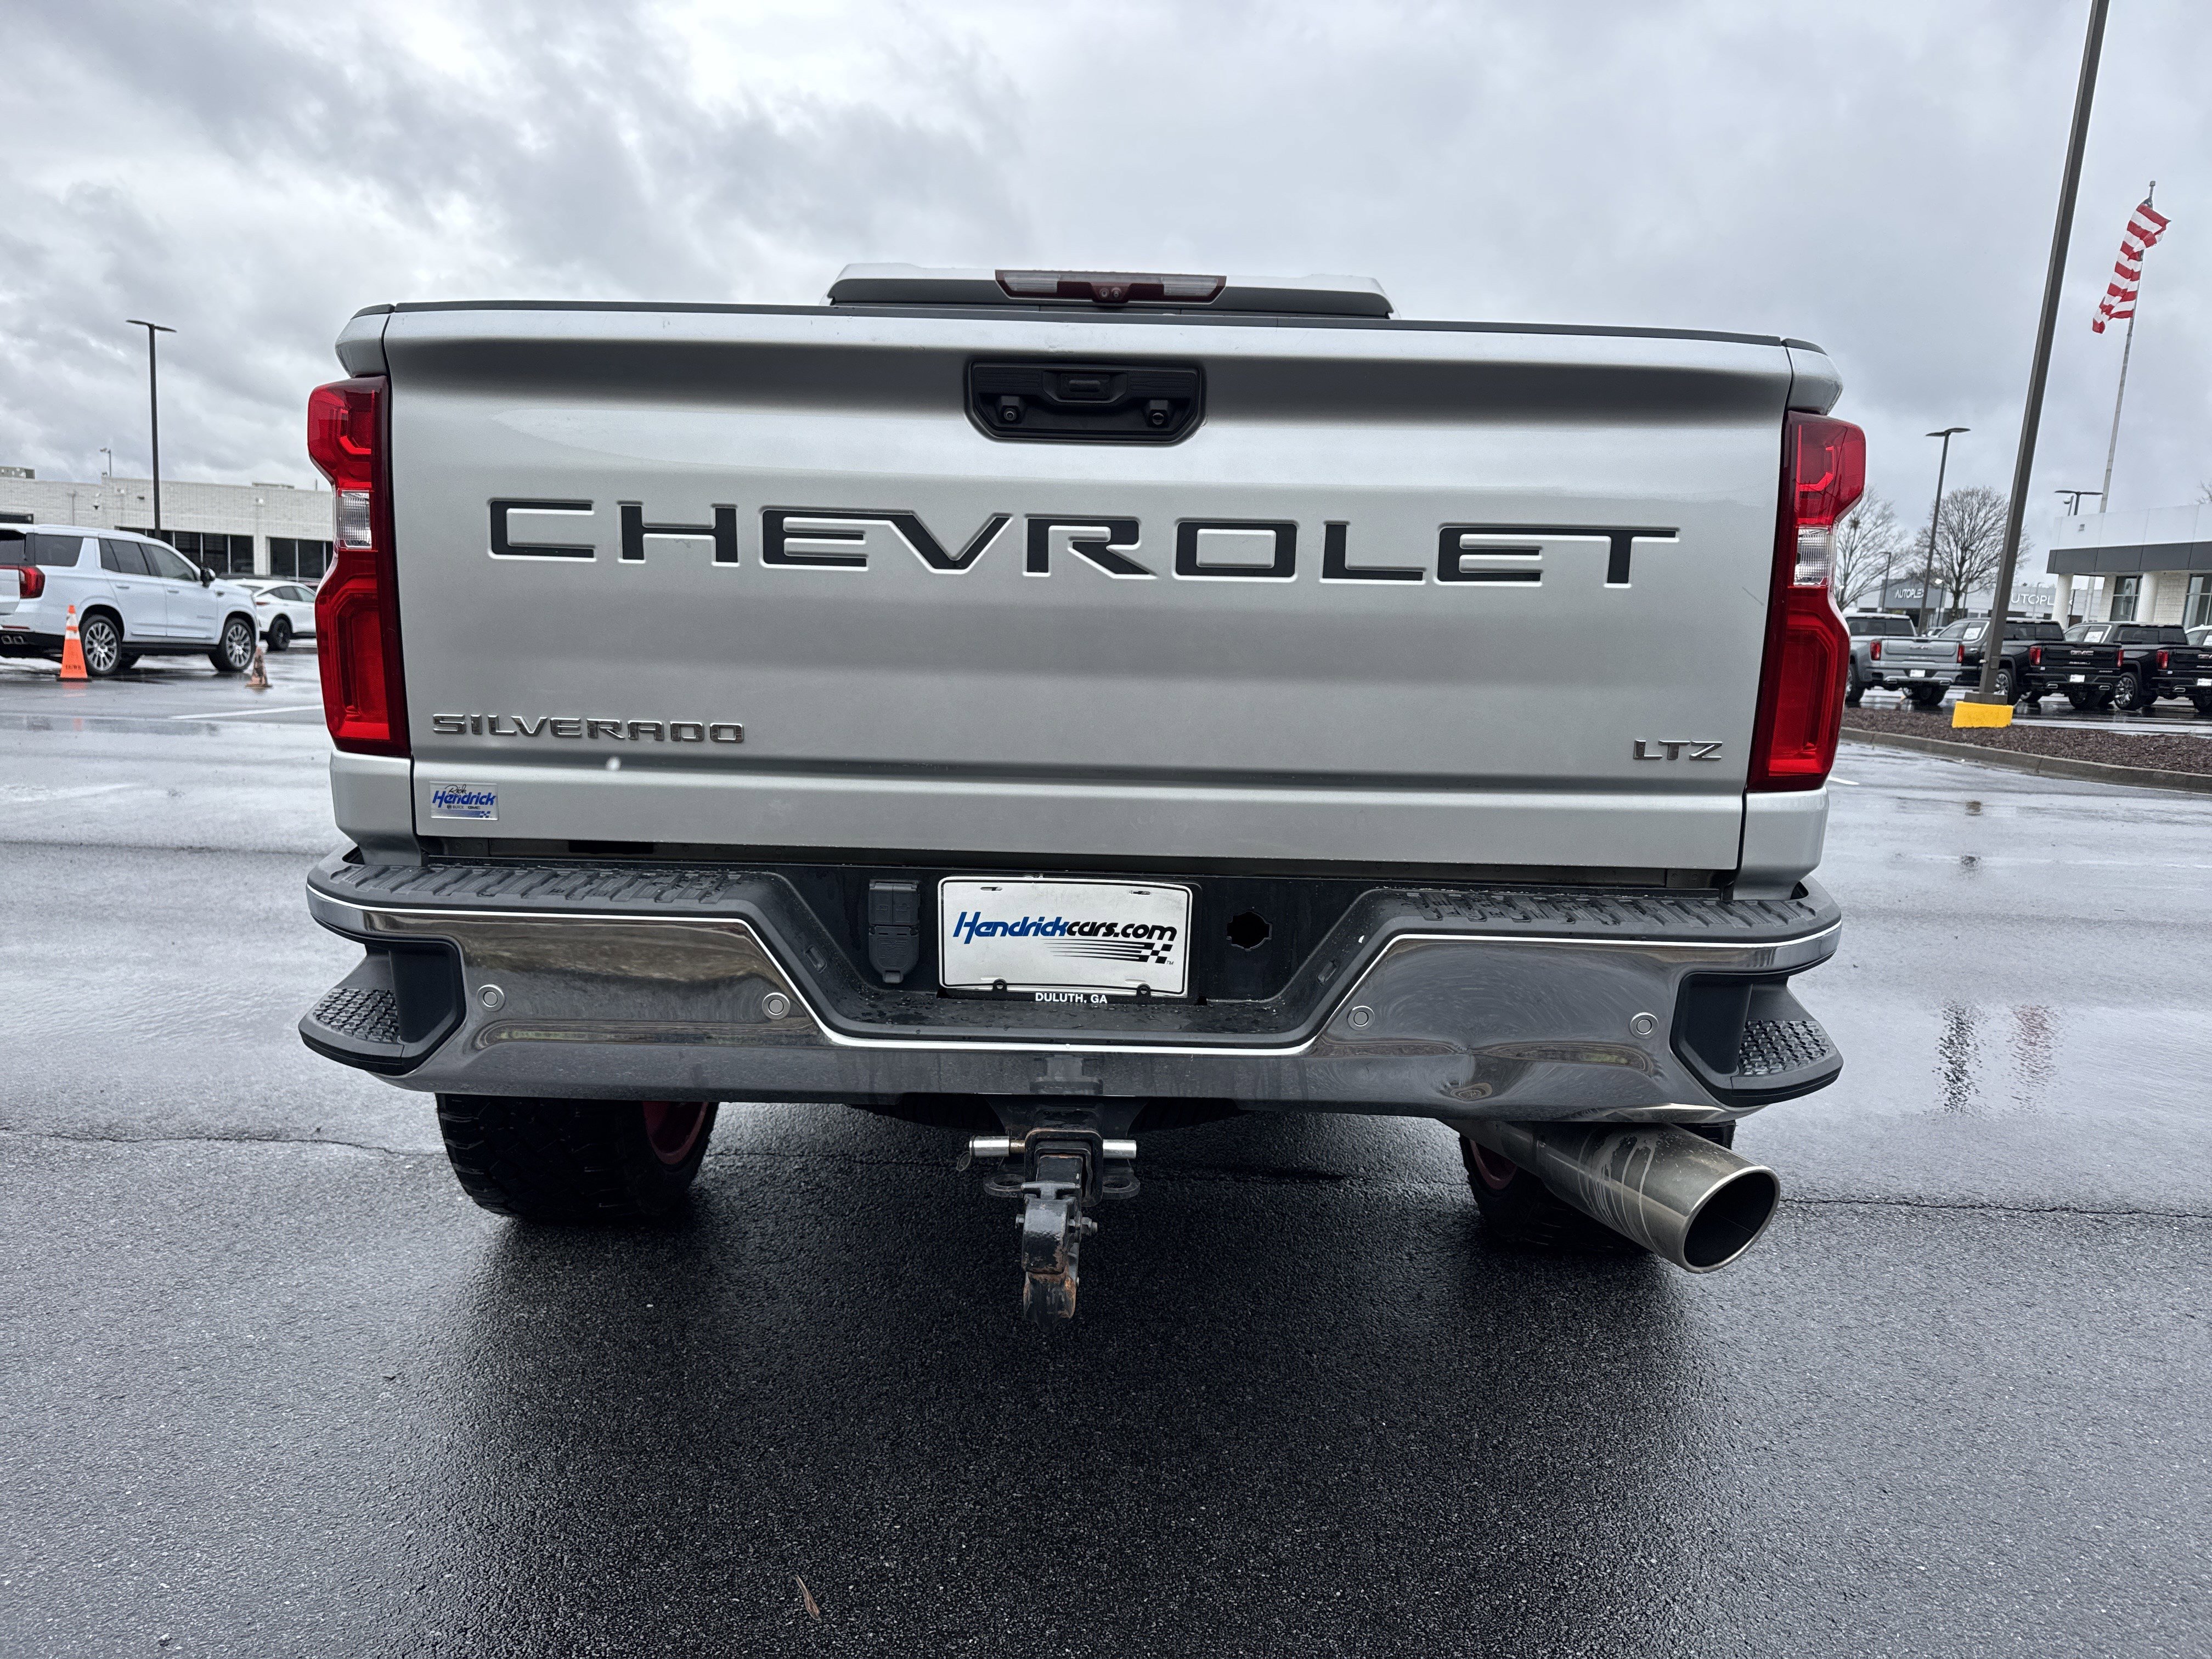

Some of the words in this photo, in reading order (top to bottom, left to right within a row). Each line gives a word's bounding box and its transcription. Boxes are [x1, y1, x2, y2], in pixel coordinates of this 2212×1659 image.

[487, 499, 1680, 588] CHEVROLET
[2011, 593, 2055, 606] UTOPL
[432, 713, 745, 743] SILVERADO
[1633, 739, 1723, 761] LTZ
[432, 790, 496, 808] Hendrick
[445, 784, 467, 798] Rick
[952, 911, 1178, 945] Hendrickcars.com
[1090, 994, 1108, 1004] GA
